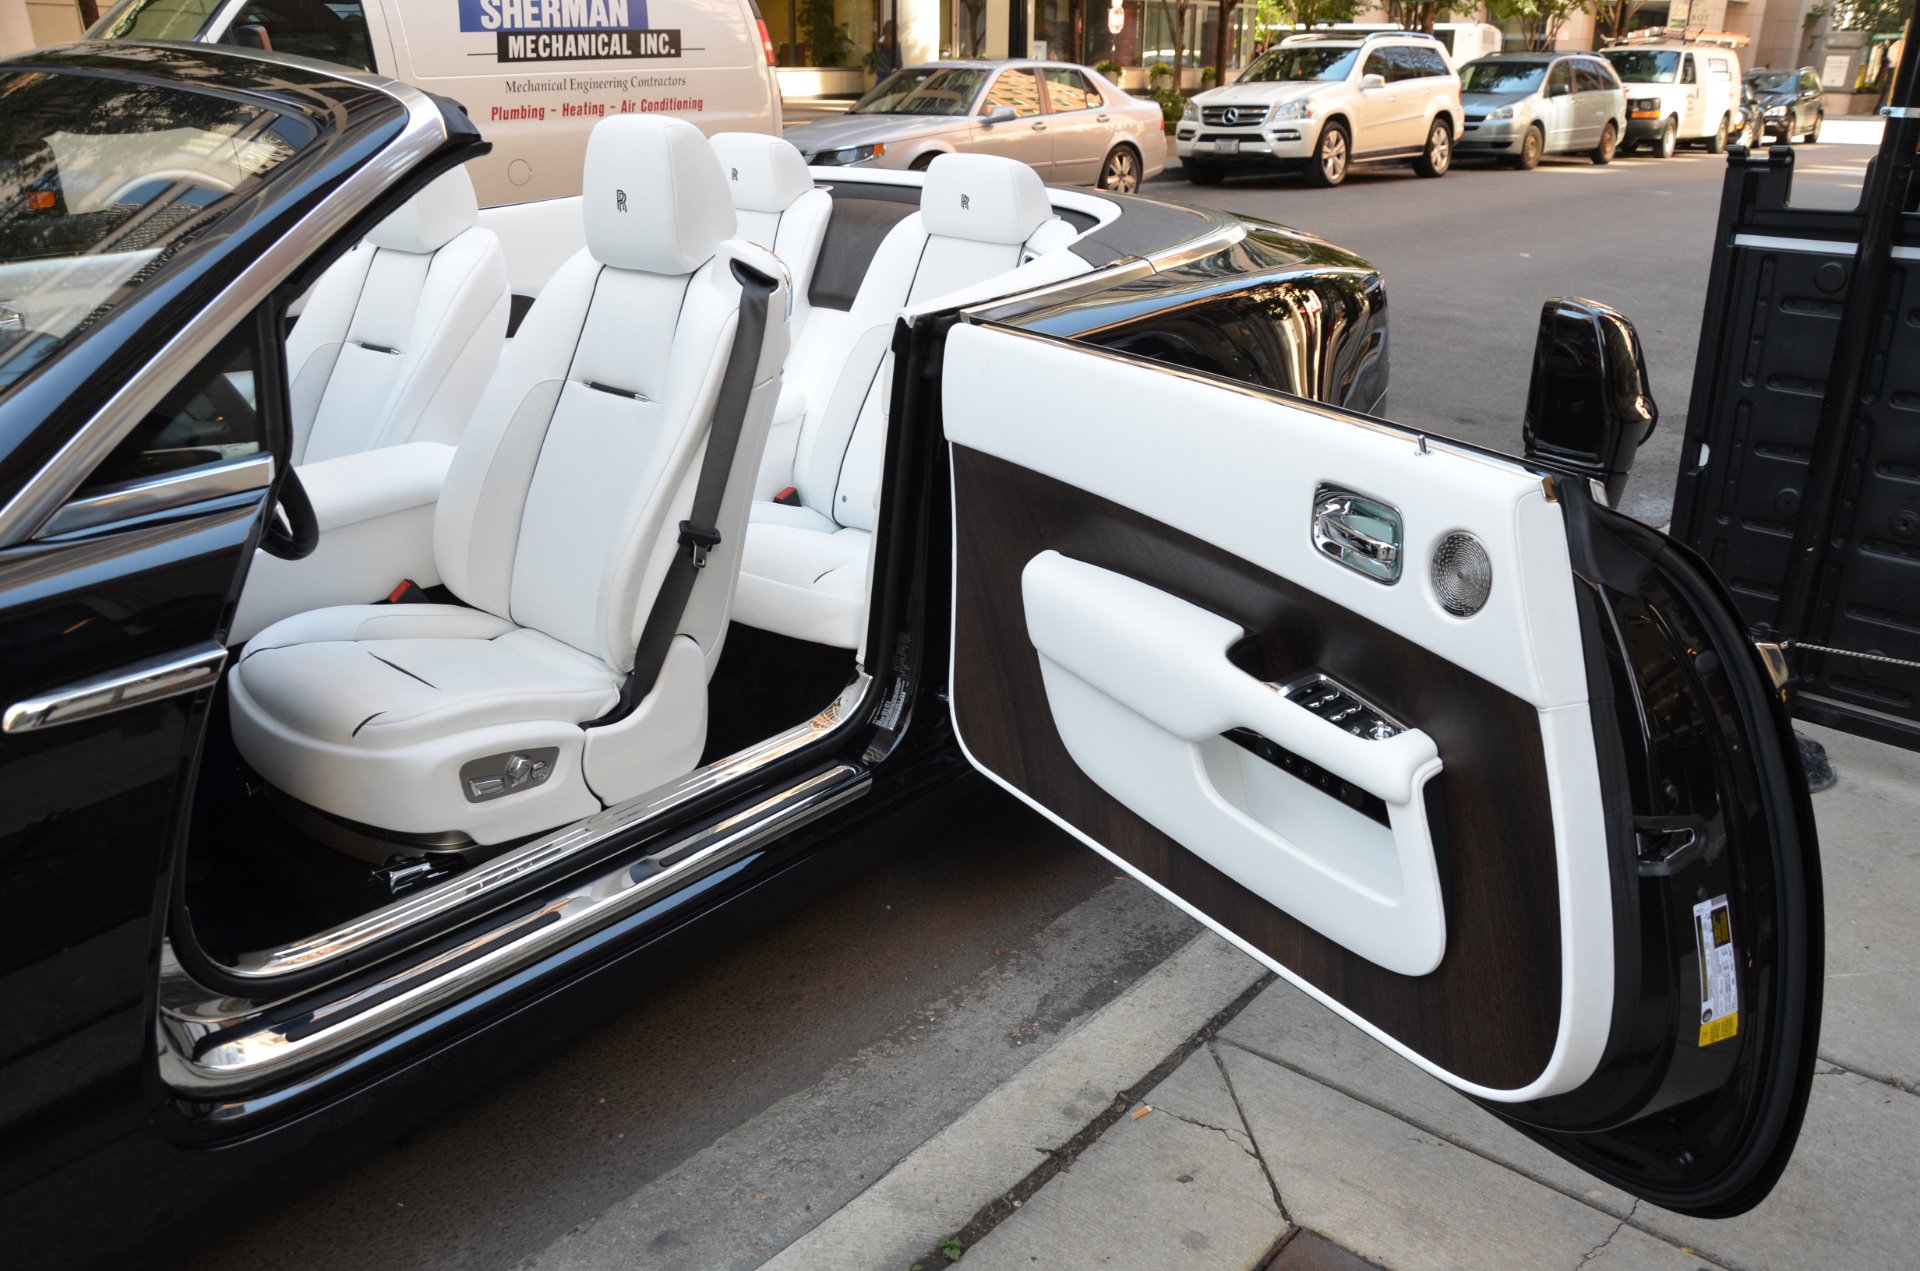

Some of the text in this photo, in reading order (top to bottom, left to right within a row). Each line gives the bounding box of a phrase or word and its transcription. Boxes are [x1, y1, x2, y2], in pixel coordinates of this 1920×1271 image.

[480, 0, 629, 30] SHERMAN
[508, 32, 676, 59] MECHANICAL INC.
[504, 75, 687, 95] Mechanical Engineering Contractors
[491, 105, 545, 121] Plumbing
[562, 101, 605, 117] Heating
[620, 99, 637, 113] Air
[641, 97, 704, 112] Conditioning
